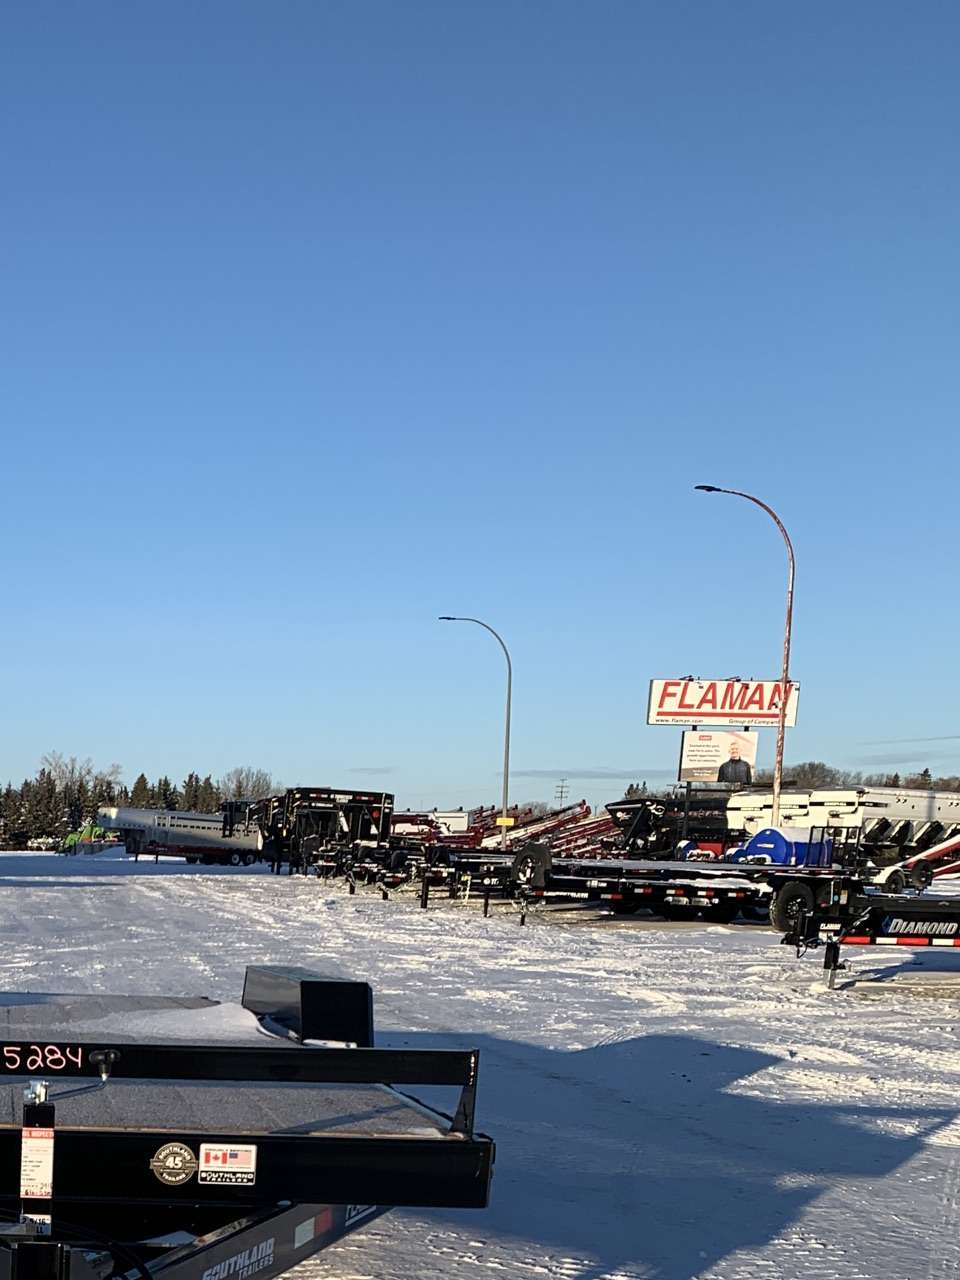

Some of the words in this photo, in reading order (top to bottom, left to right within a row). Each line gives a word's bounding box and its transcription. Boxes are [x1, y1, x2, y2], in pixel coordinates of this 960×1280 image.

[658, 681, 792, 711] FLAMAN
[889, 918, 958, 936] DIAMOND
[165, 1157, 182, 1169] 45
[200, 1171, 254, 1179] SOUTHLAND
[239, 1254, 275, 1280] TRAILERS
